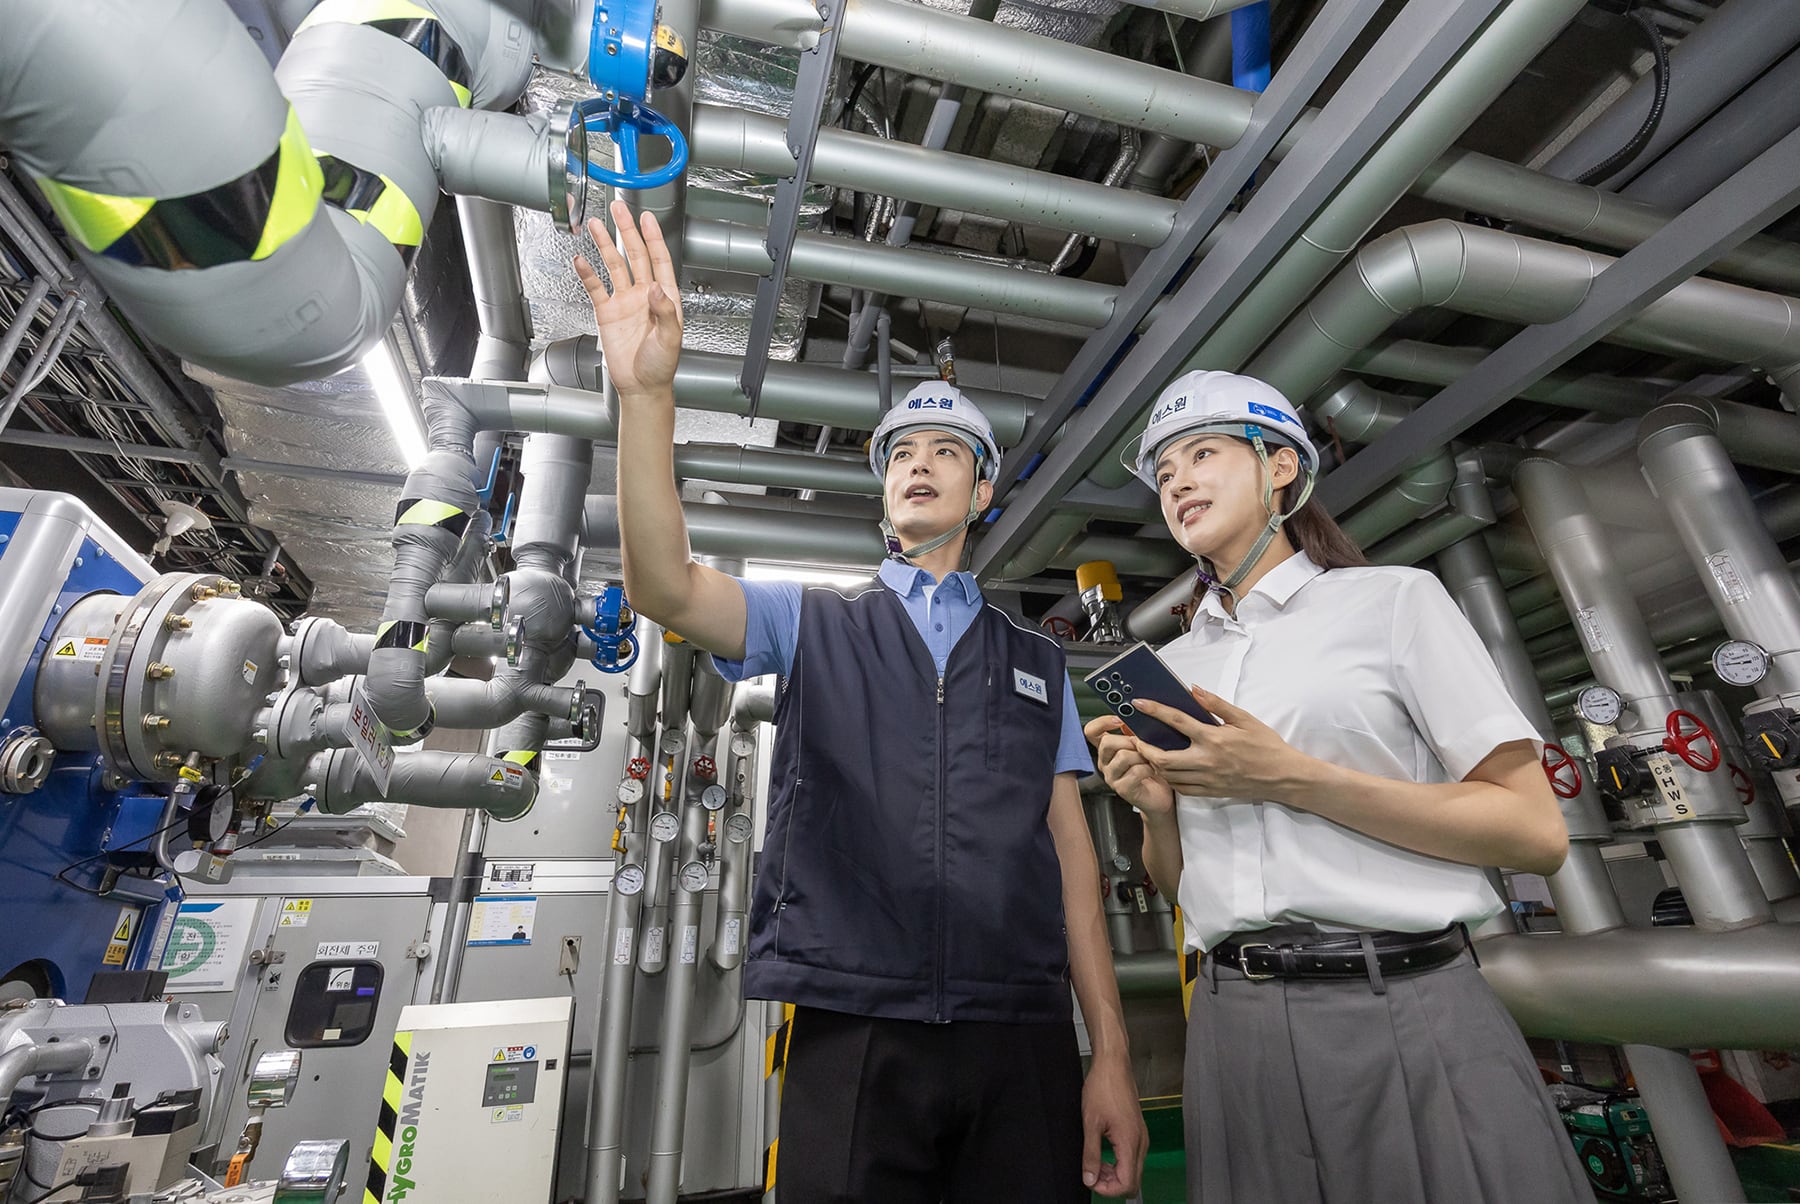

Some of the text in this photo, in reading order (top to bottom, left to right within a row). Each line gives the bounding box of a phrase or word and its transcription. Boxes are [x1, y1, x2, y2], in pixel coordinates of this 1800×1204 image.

[908, 397, 953, 410] 에스원
[1152, 396, 1187, 424] 에스원
[1020, 677, 1042, 695] 에스원
[352, 704, 378, 751] 보일러
[357, 944, 378, 955] 주의
